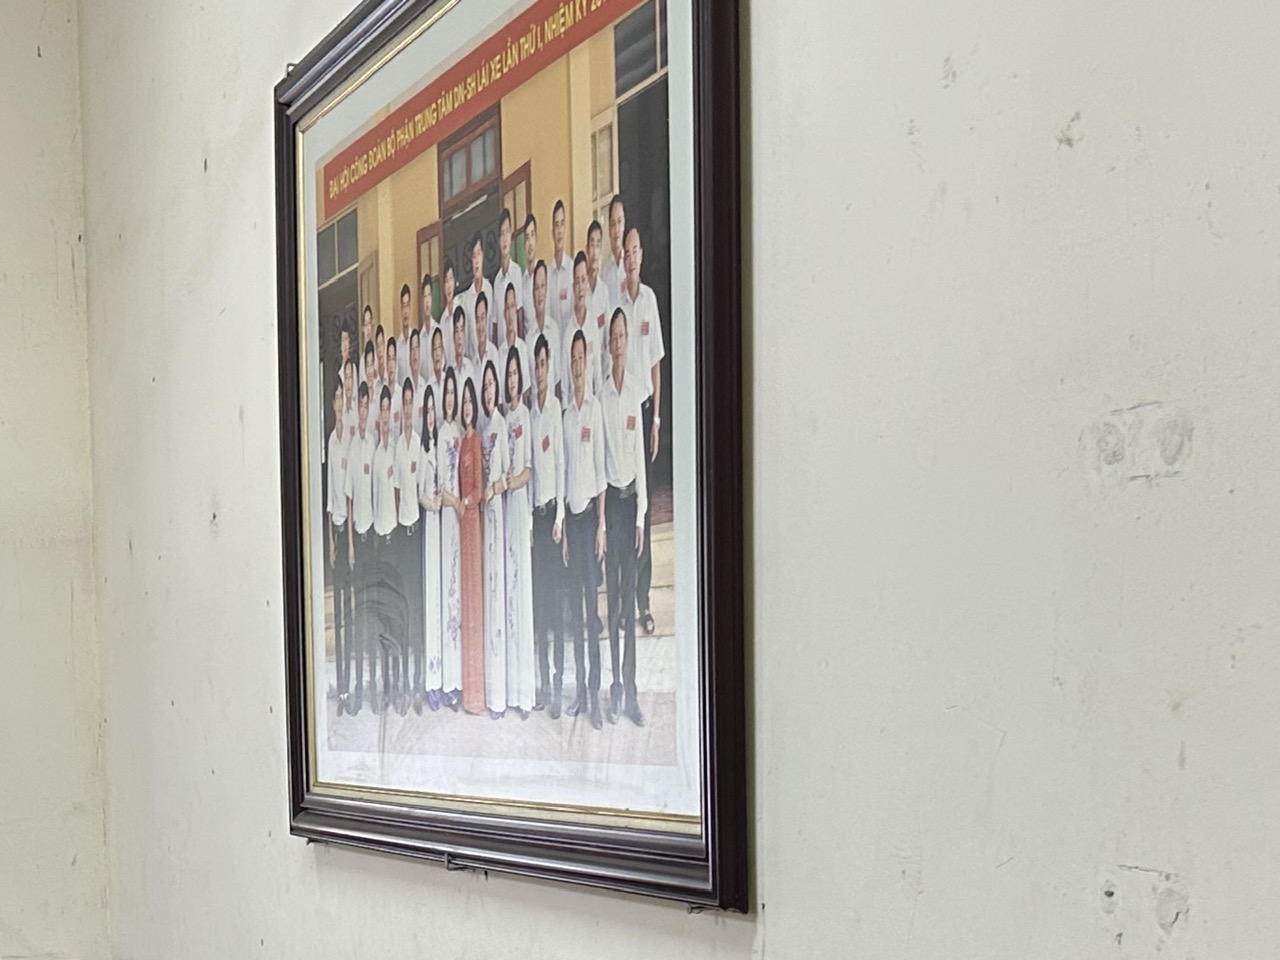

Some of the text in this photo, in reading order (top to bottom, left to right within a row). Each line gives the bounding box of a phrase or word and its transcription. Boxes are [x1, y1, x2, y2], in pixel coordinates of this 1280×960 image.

[350, 154, 368, 183] CÔNG
[414, 102, 438, 138] TRUNG
[437, 90, 453, 121] TÂM
[476, 59, 489, 92] LÁI
[489, 54, 502, 84] XE
[502, 36, 519, 74] LẦN
[544, 1, 574, 45] NHIỆM
